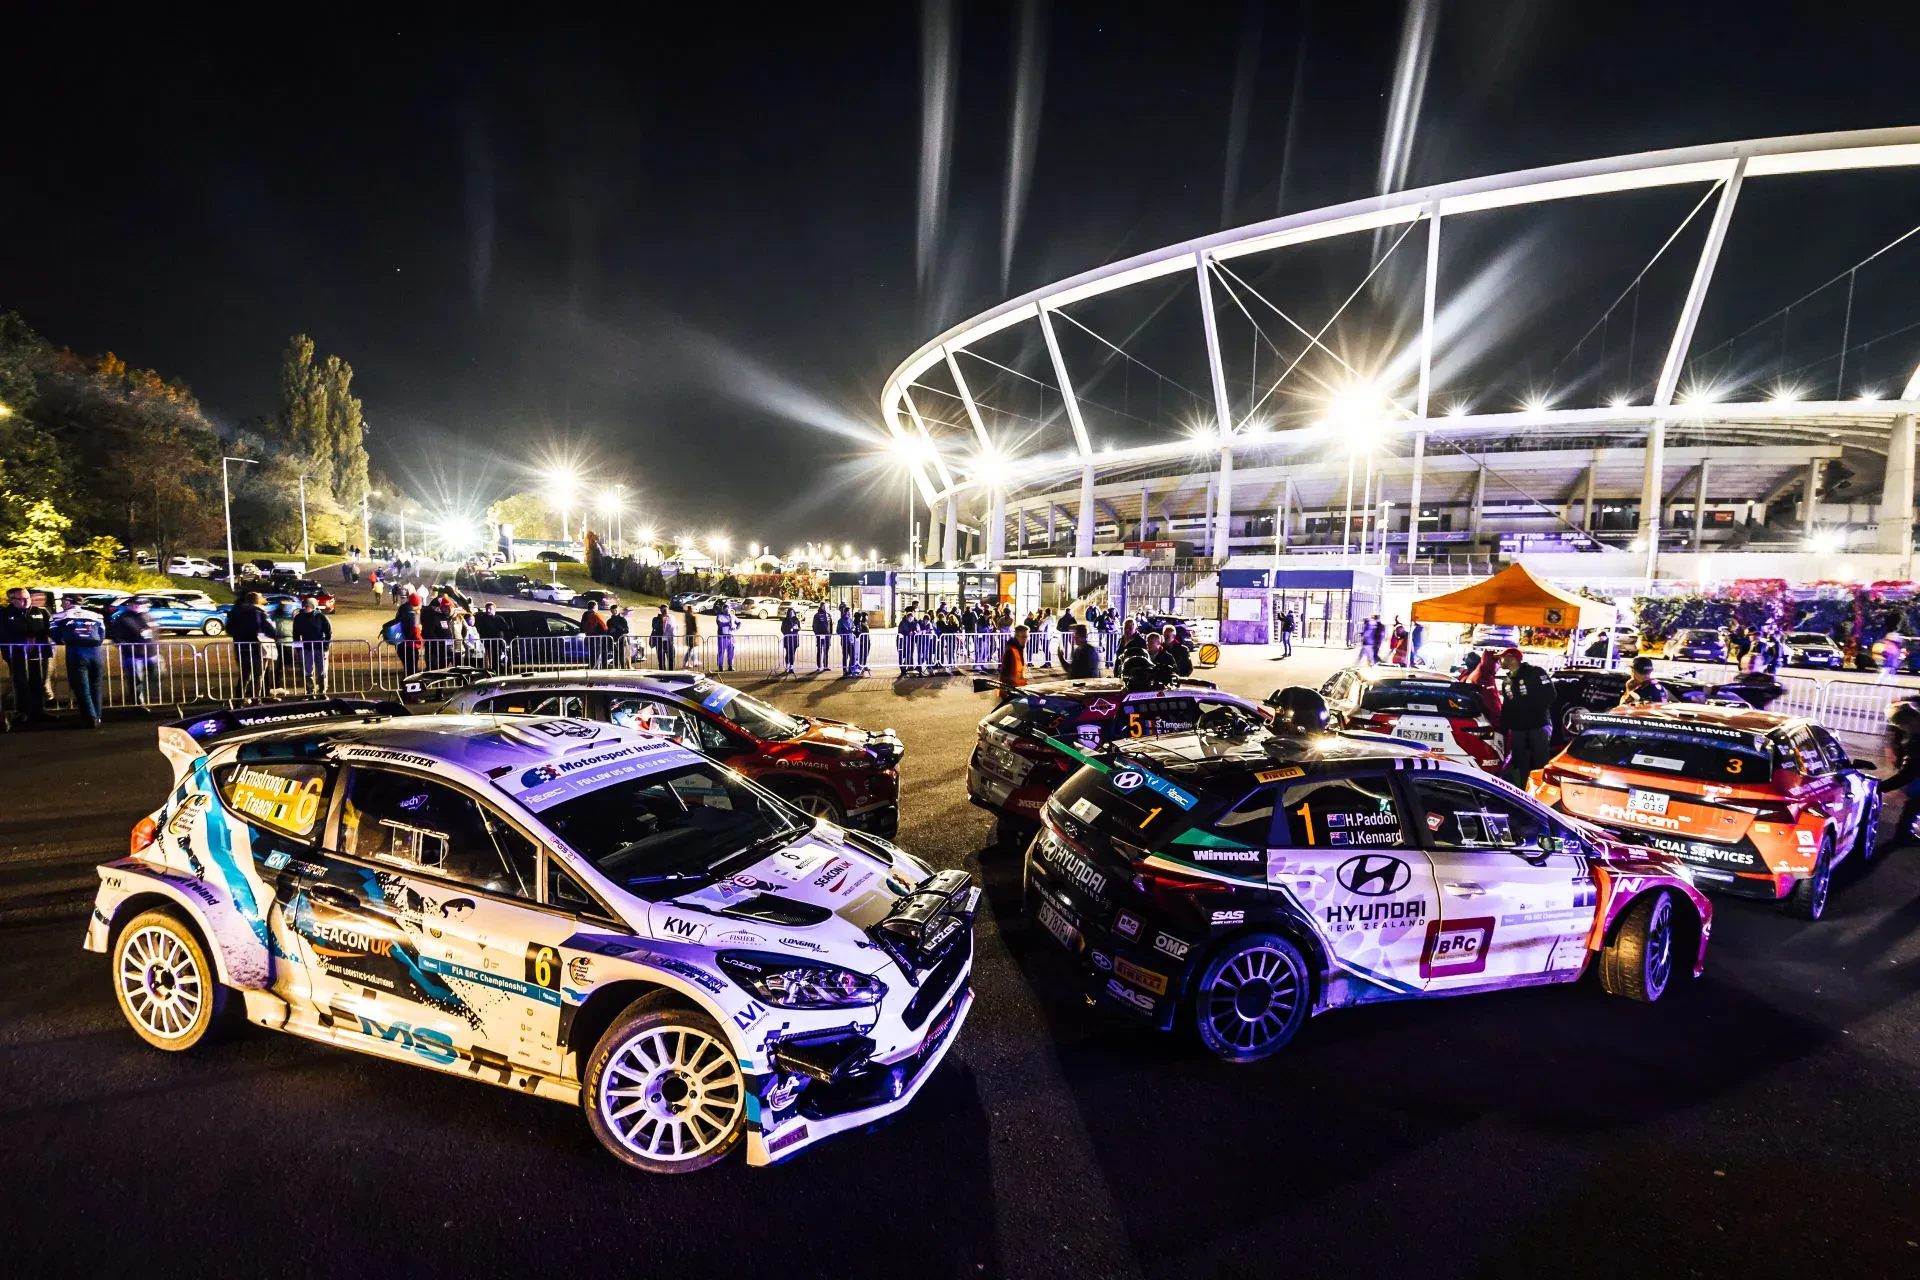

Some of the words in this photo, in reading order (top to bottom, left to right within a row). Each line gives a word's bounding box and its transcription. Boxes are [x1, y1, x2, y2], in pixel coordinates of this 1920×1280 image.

[863, 574, 868, 585] 1
[1262, 573, 1269, 587] 1
[239, 709, 328, 727] Motorsport
[1129, 713, 1142, 738] 5
[1580, 715, 1641, 725] VOLKSWAGEN
[1643, 720, 1694, 732] FINANCIAL
[1695, 726, 1741, 738] SERVICES
[347, 749, 436, 768] THRUSTMASTER
[559, 748, 634, 773] Motorsport
[634, 741, 671, 755] Ireland
[1726, 758, 1743, 774] 3
[228, 764, 241, 782] J
[236, 764, 285, 795] Armstrong
[232, 790, 245, 809] E
[246, 792, 275, 820] Treacy
[295, 777, 323, 824] 6
[1643, 803, 1664, 812] 015
[1139, 807, 1163, 829] 1
[1297, 802, 1316, 846] 1
[1345, 813, 1397, 828] H.Paddon
[1349, 830, 1403, 846] J.Kennard
[1690, 844, 1754, 865] SERVICES
[814, 865, 846, 888] SEACON
[1056, 845, 1108, 894] HYUNDAI
[186, 878, 221, 906] Ireland
[1212, 910, 1245, 920] SAS
[1327, 901, 1426, 924] HYUNDAI
[663, 916, 698, 937] KW
[923, 921, 963, 951] LAZER
[1364, 919, 1425, 931] ZEALAND
[312, 922, 369, 952] SEACON
[370, 940, 393, 958] UK
[783, 938, 821, 950] LONGHILL
[1155, 935, 1189, 957] OMP
[1438, 935, 1477, 955] BRC
[535, 947, 554, 987] 6
[452, 966, 464, 978] FIA
[465, 969, 479, 980] ERC
[480, 973, 528, 994] Championship
[1106, 978, 1156, 1011] SAS
[733, 1000, 766, 1031] LVI
